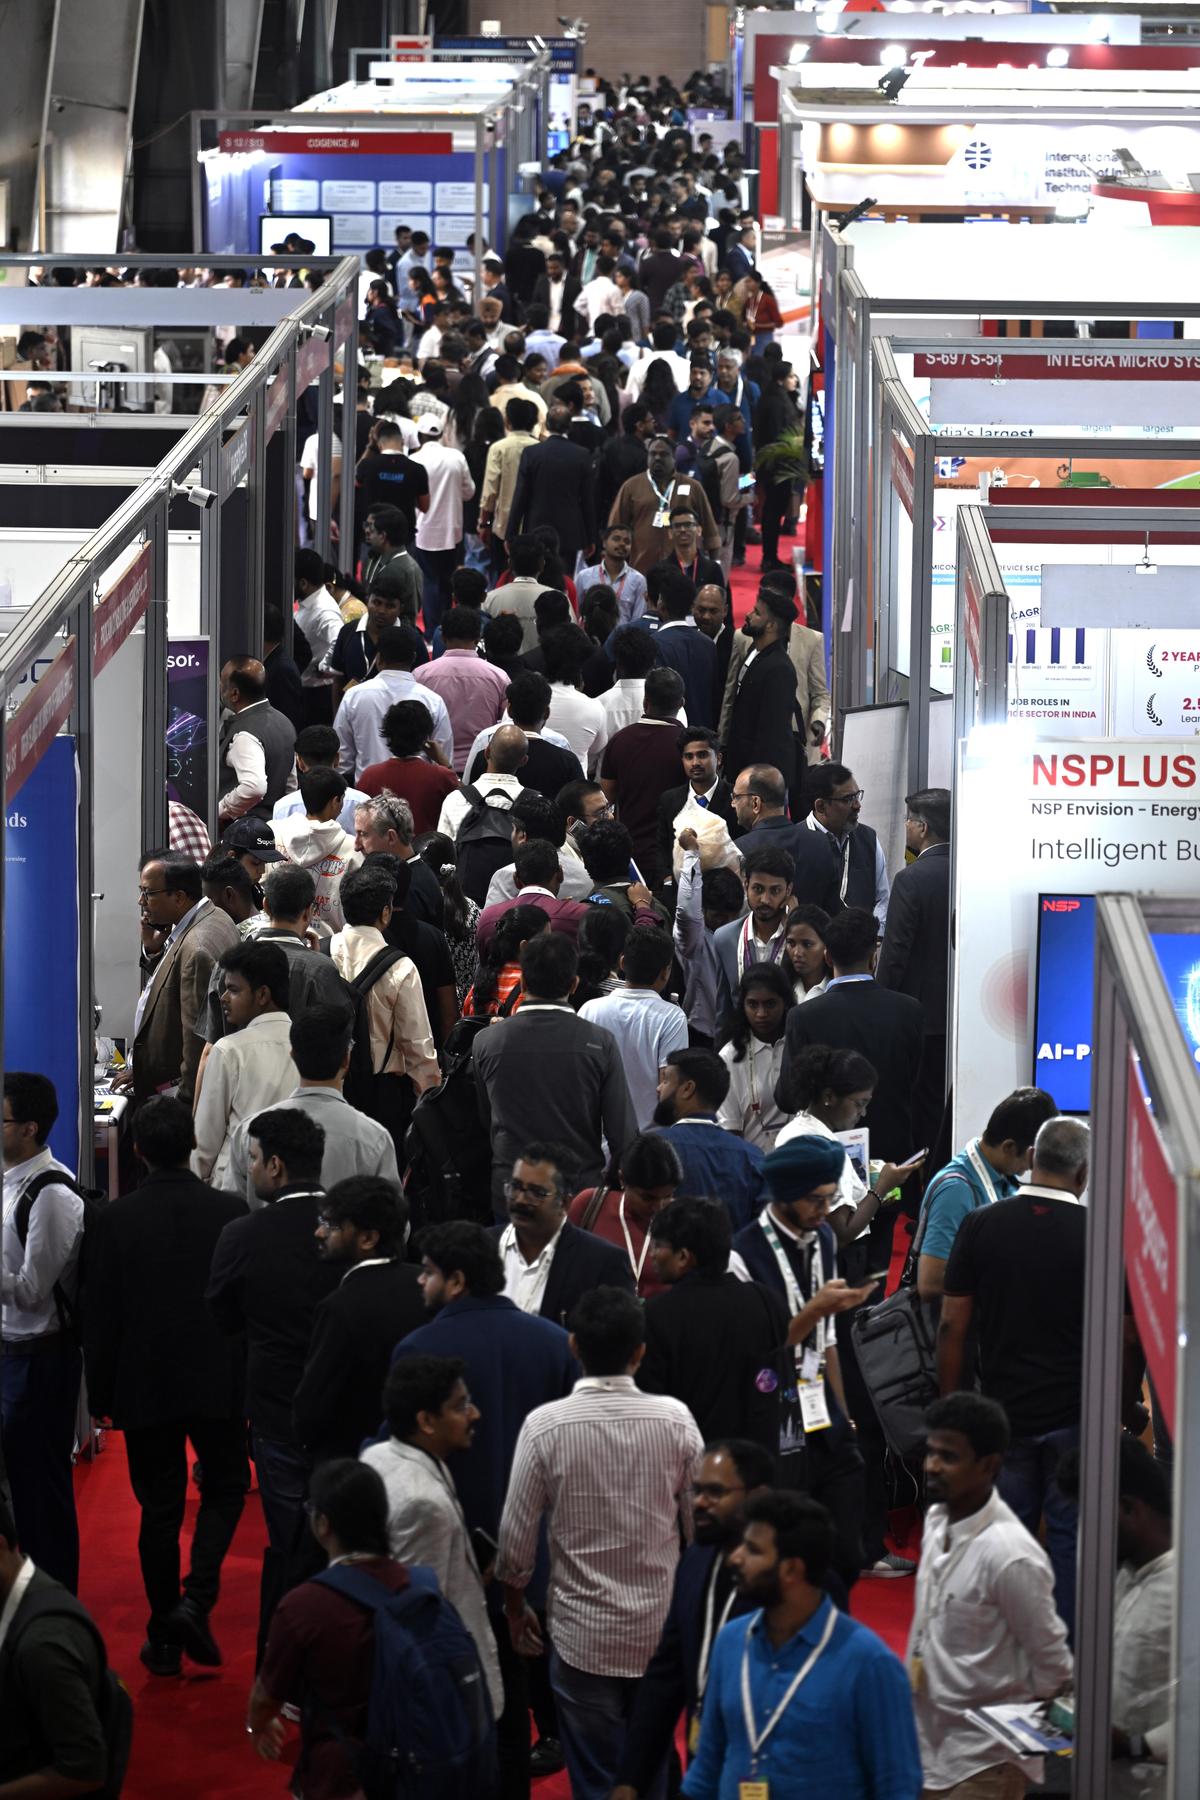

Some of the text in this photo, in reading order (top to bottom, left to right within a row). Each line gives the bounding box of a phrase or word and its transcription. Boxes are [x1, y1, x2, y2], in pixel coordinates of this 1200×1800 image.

[926, 354, 958, 365] S-69
[961, 354, 967, 365] /
[1047, 354, 1115, 368] INTEGRA
[1119, 354, 1170, 368] MICRO
[1161, 651, 1169, 661] 2
[1010, 698, 1029, 706] JOB
[1031, 698, 1059, 706] ROLES
[1072, 711, 1097, 719] INDIA
[1032, 754, 1197, 788] NSPLUS
[1031, 803, 1062, 815] NSP
[1067, 802, 1133, 816] Envision
[1151, 803, 1200, 821] Energ
[1032, 838, 1167, 868] Intelligent
[1042, 900, 1081, 912] NSP
